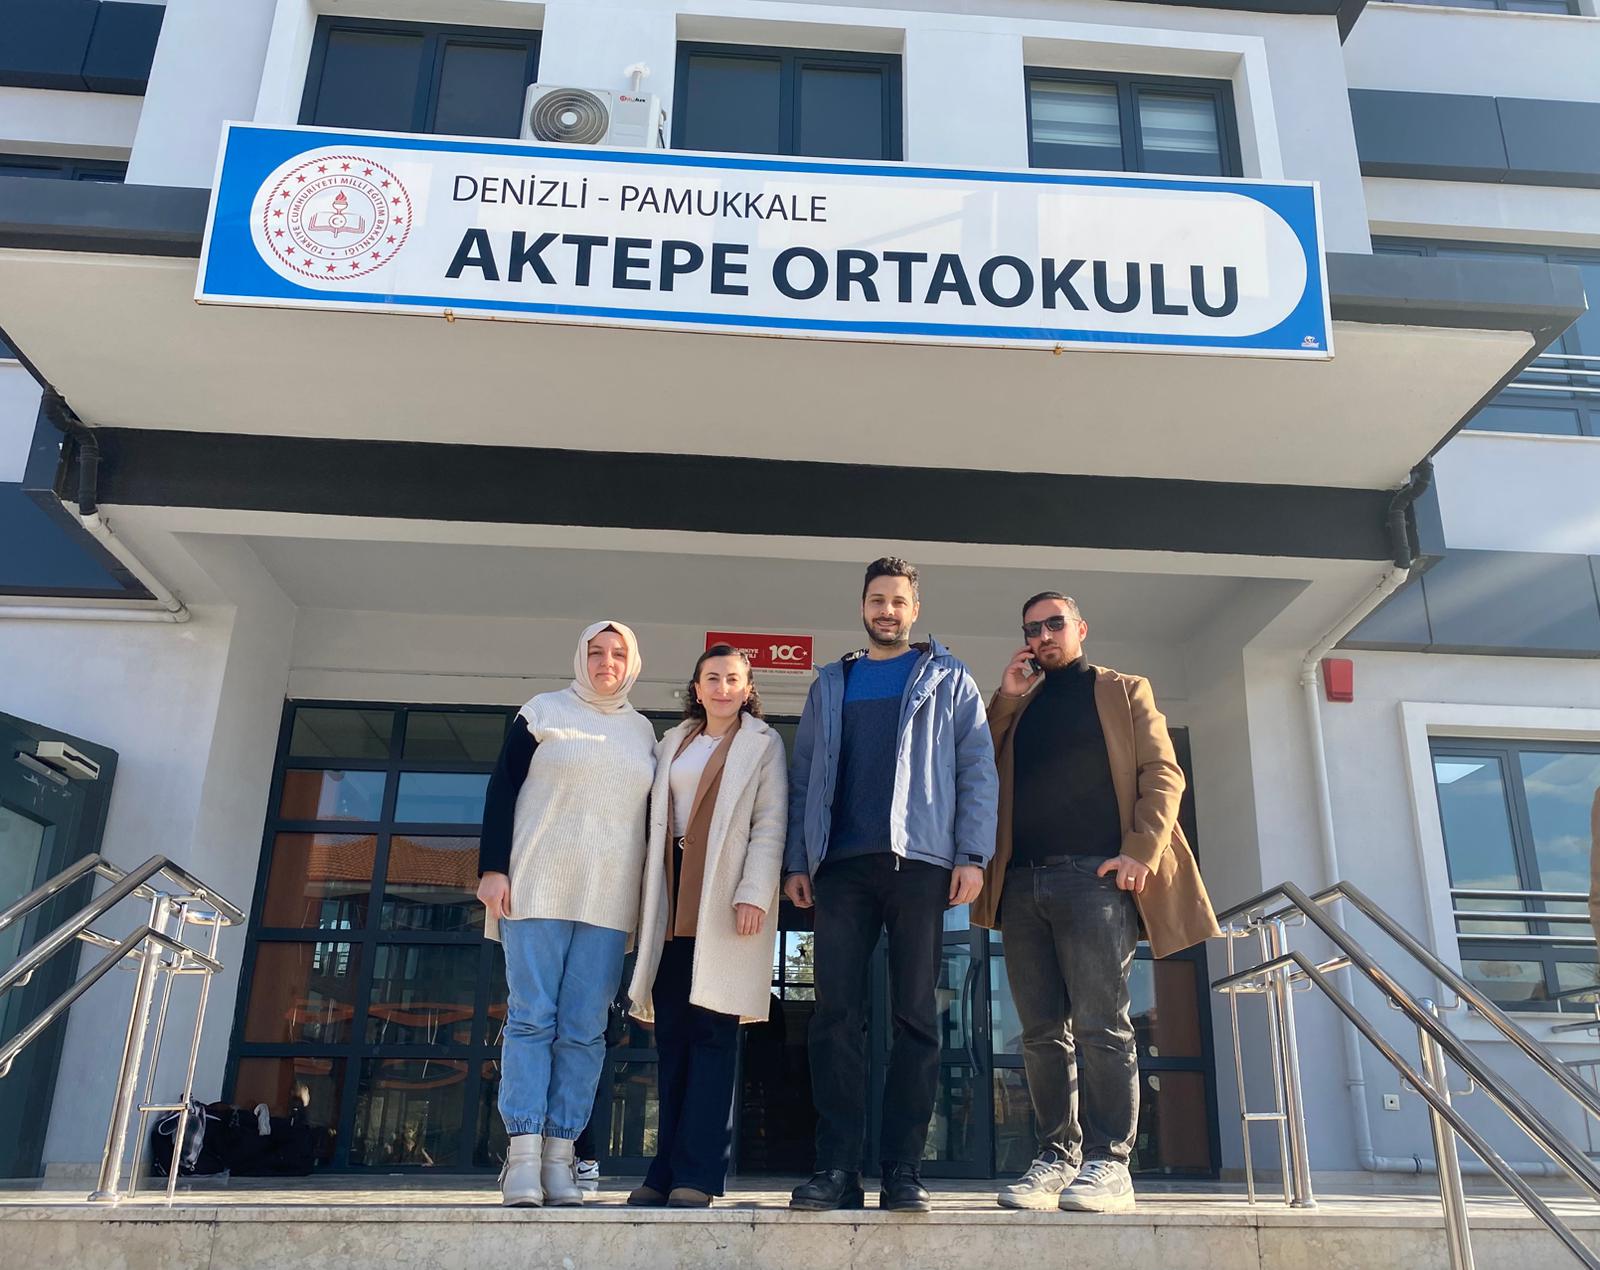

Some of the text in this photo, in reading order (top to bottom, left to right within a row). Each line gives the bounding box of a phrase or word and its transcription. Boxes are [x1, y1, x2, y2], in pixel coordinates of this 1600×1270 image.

[291, 177, 385, 257] TÜRKİYE CUMHURİYETİ MİLLİ EĞİTİM BAKANLIĞI
[453, 174, 588, 209] DENİZLİ
[620, 185, 827, 222] PAMUKKALE
[445, 229, 1239, 318] AKTEPE ORTAOKULU
